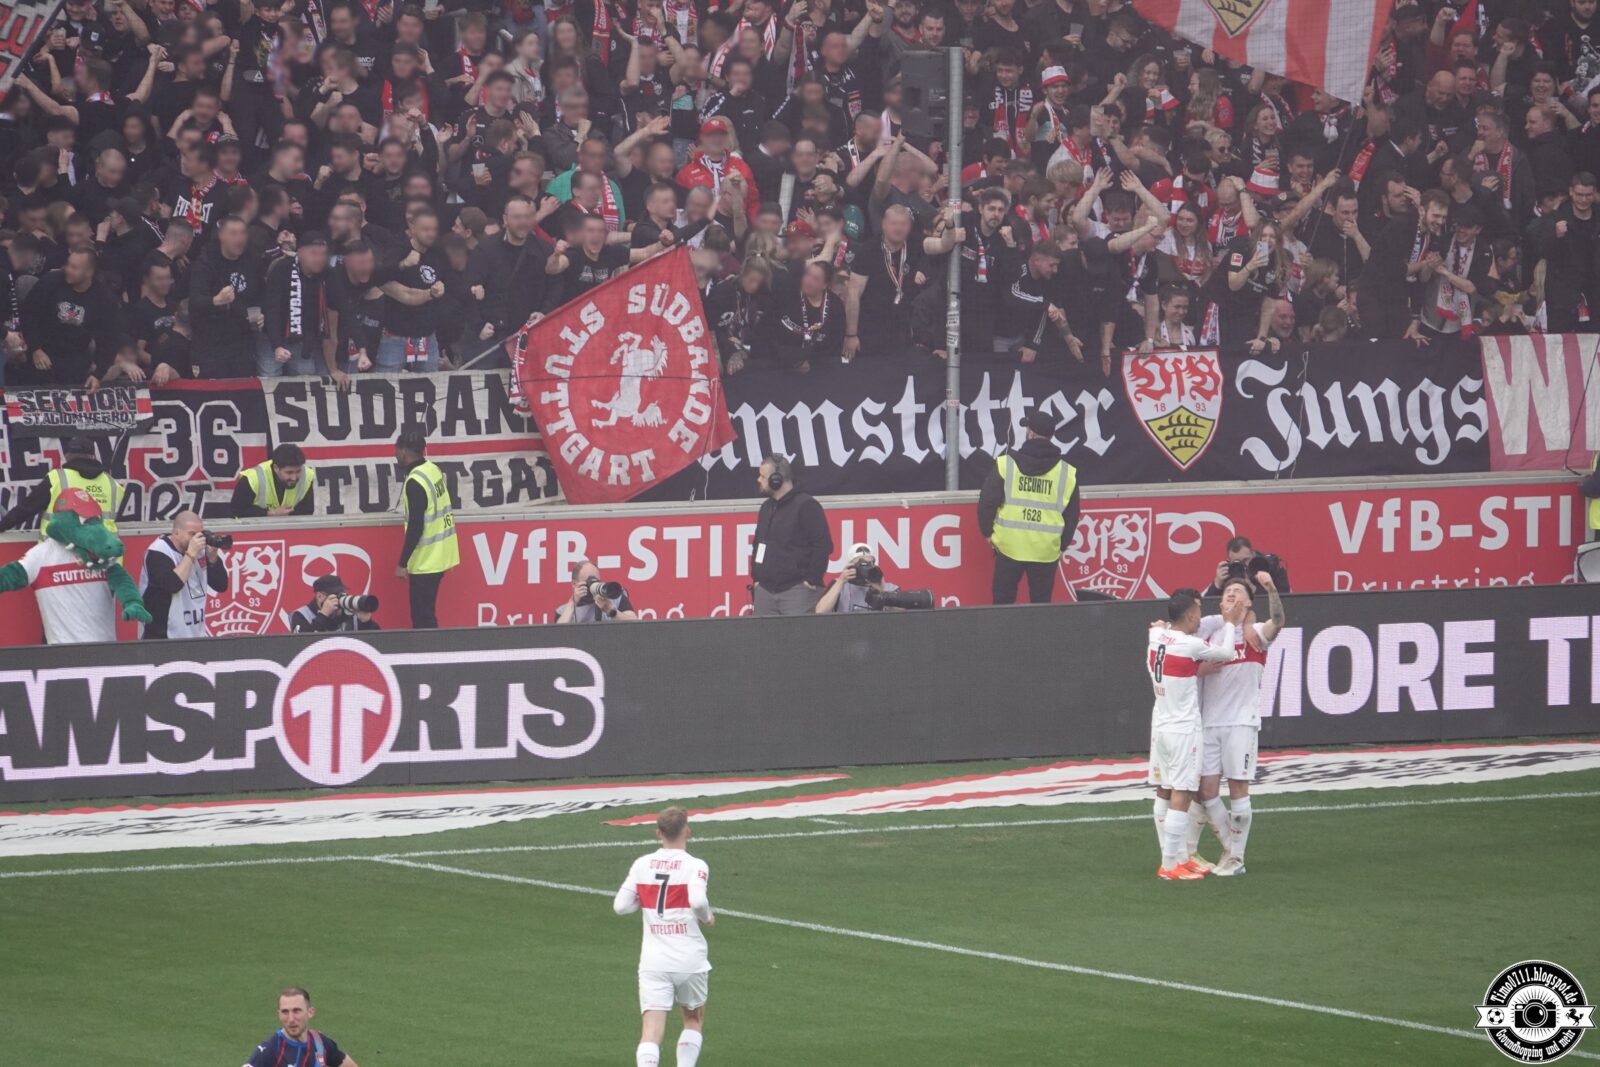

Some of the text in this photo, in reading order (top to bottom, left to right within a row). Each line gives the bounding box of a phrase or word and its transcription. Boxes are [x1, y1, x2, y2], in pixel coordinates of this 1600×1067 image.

[540, 282, 712, 486] SÜDBANDE STUTTGART
[16, 386, 138, 415] SEKTION
[272, 373, 543, 442] SÜDBAN
[1153, 402, 1207, 413] 18 93
[1235, 358, 1490, 473] Jungs
[1018, 476, 1053, 496] SECURITY
[1021, 507, 1042, 523] 1628
[52, 567, 107, 583] STUTTGART
[1078, 563, 1128, 575] 18 93
[249, 597, 261, 608] 93
[1154, 643, 1166, 684] 8
[655, 873, 670, 918] 7
